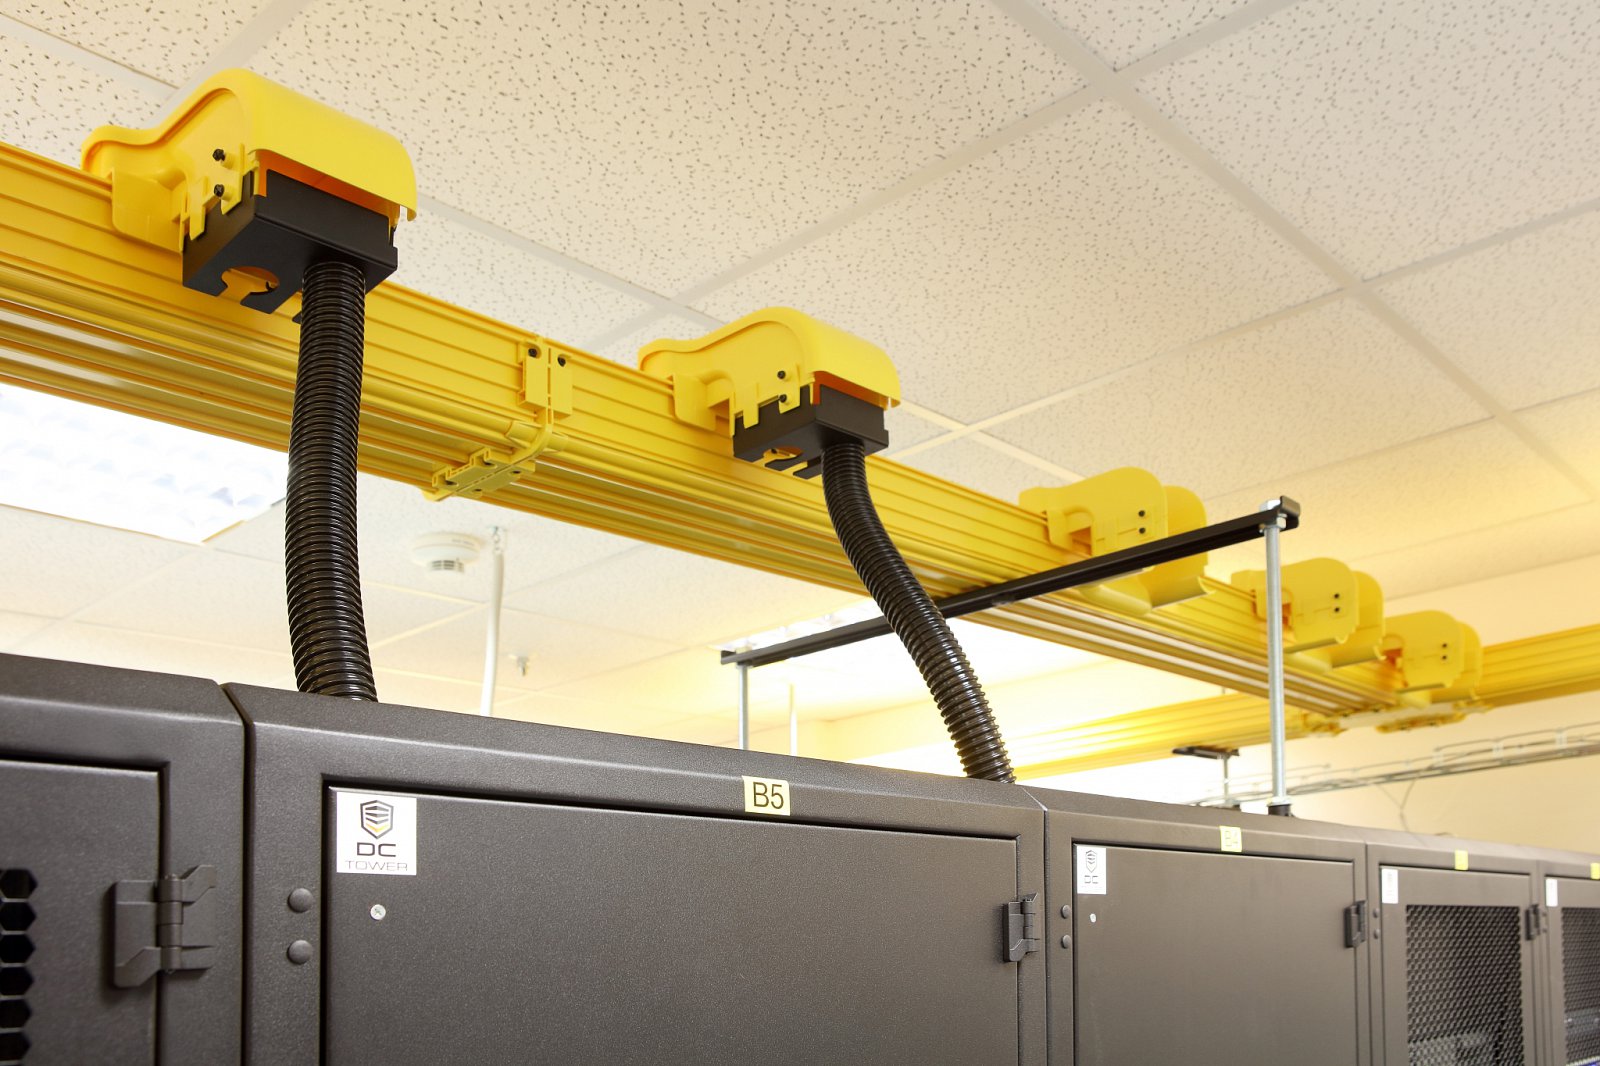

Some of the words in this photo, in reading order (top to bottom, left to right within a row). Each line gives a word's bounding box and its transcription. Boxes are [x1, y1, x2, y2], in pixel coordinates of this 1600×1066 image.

[753, 781, 784, 809] B5
[356, 842, 396, 857] DC
[345, 860, 408, 872] TOWER
